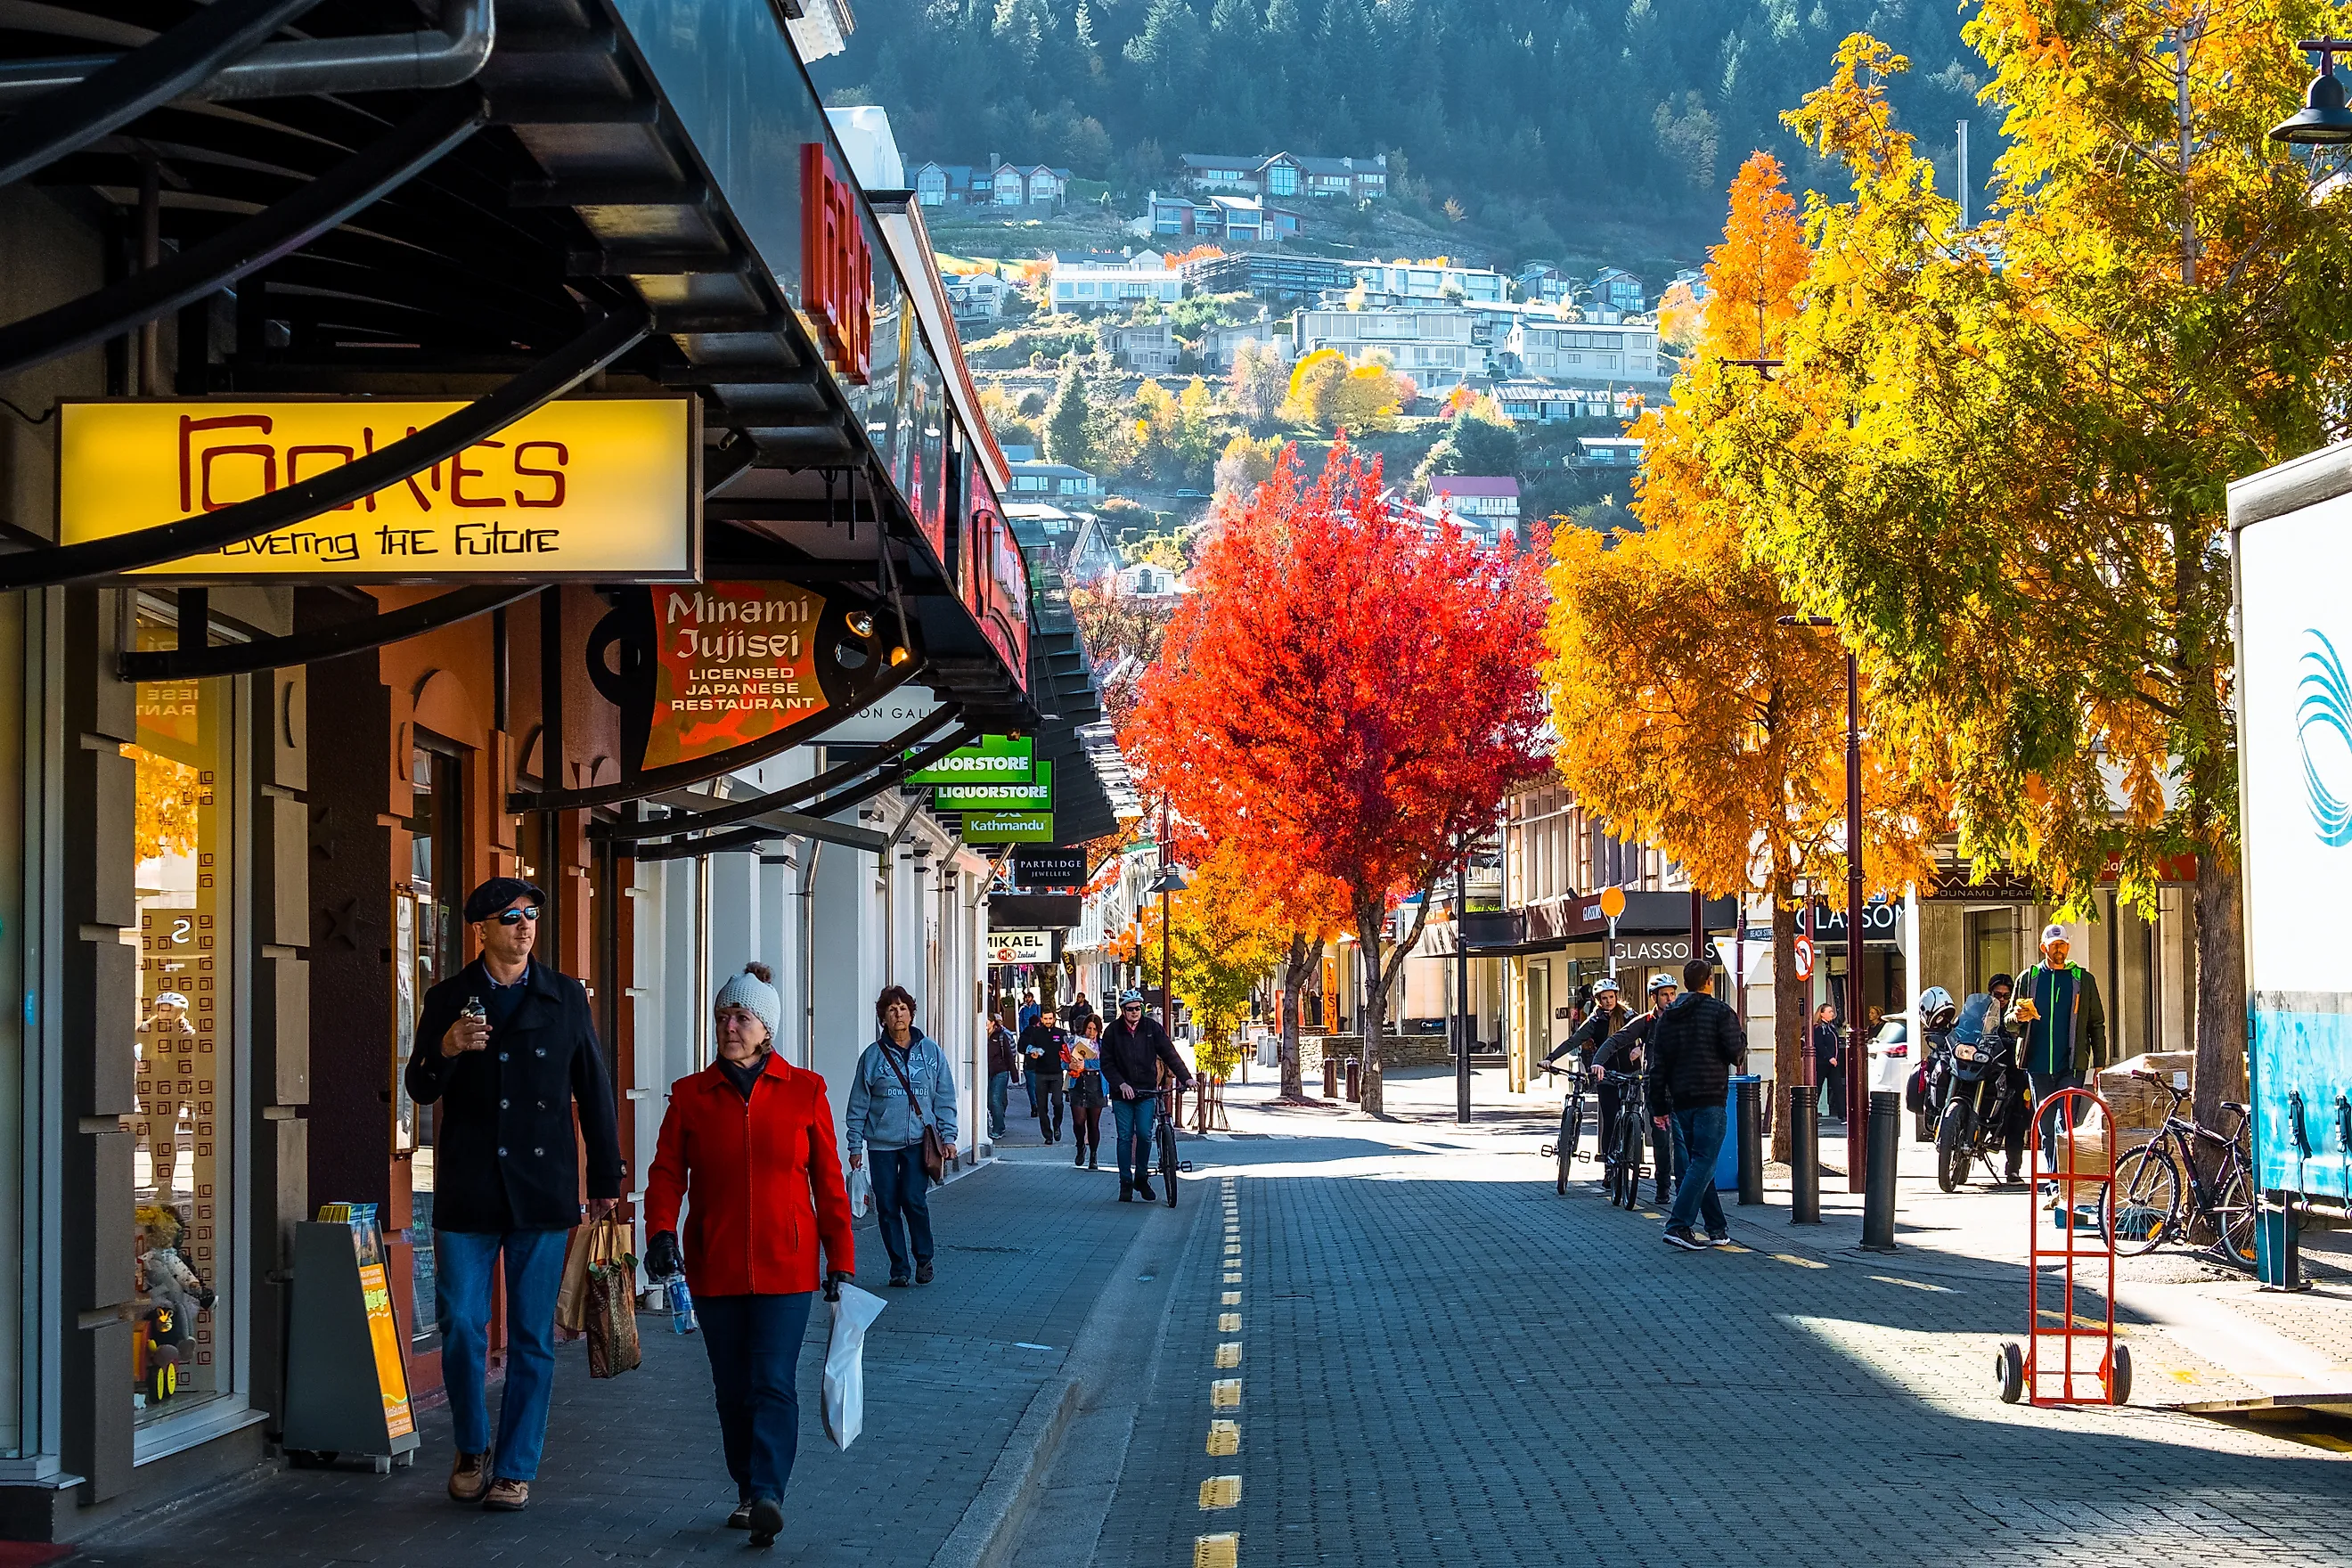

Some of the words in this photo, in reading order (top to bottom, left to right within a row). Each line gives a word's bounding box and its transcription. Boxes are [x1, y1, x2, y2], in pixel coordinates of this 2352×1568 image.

[668, 591, 809, 625] Minami
[676, 627, 800, 664] Jujisei
[689, 667, 795, 681] LICENSED
[685, 682, 799, 696] JAPANESE
[671, 698, 815, 711] RESTAURANT
[938, 786, 1048, 799] LIQUORSTORE
[970, 820, 1044, 831] Kathmandu
[1020, 860, 1082, 868] PARTRIDGE
[1614, 942, 1716, 960] GLASSOS
